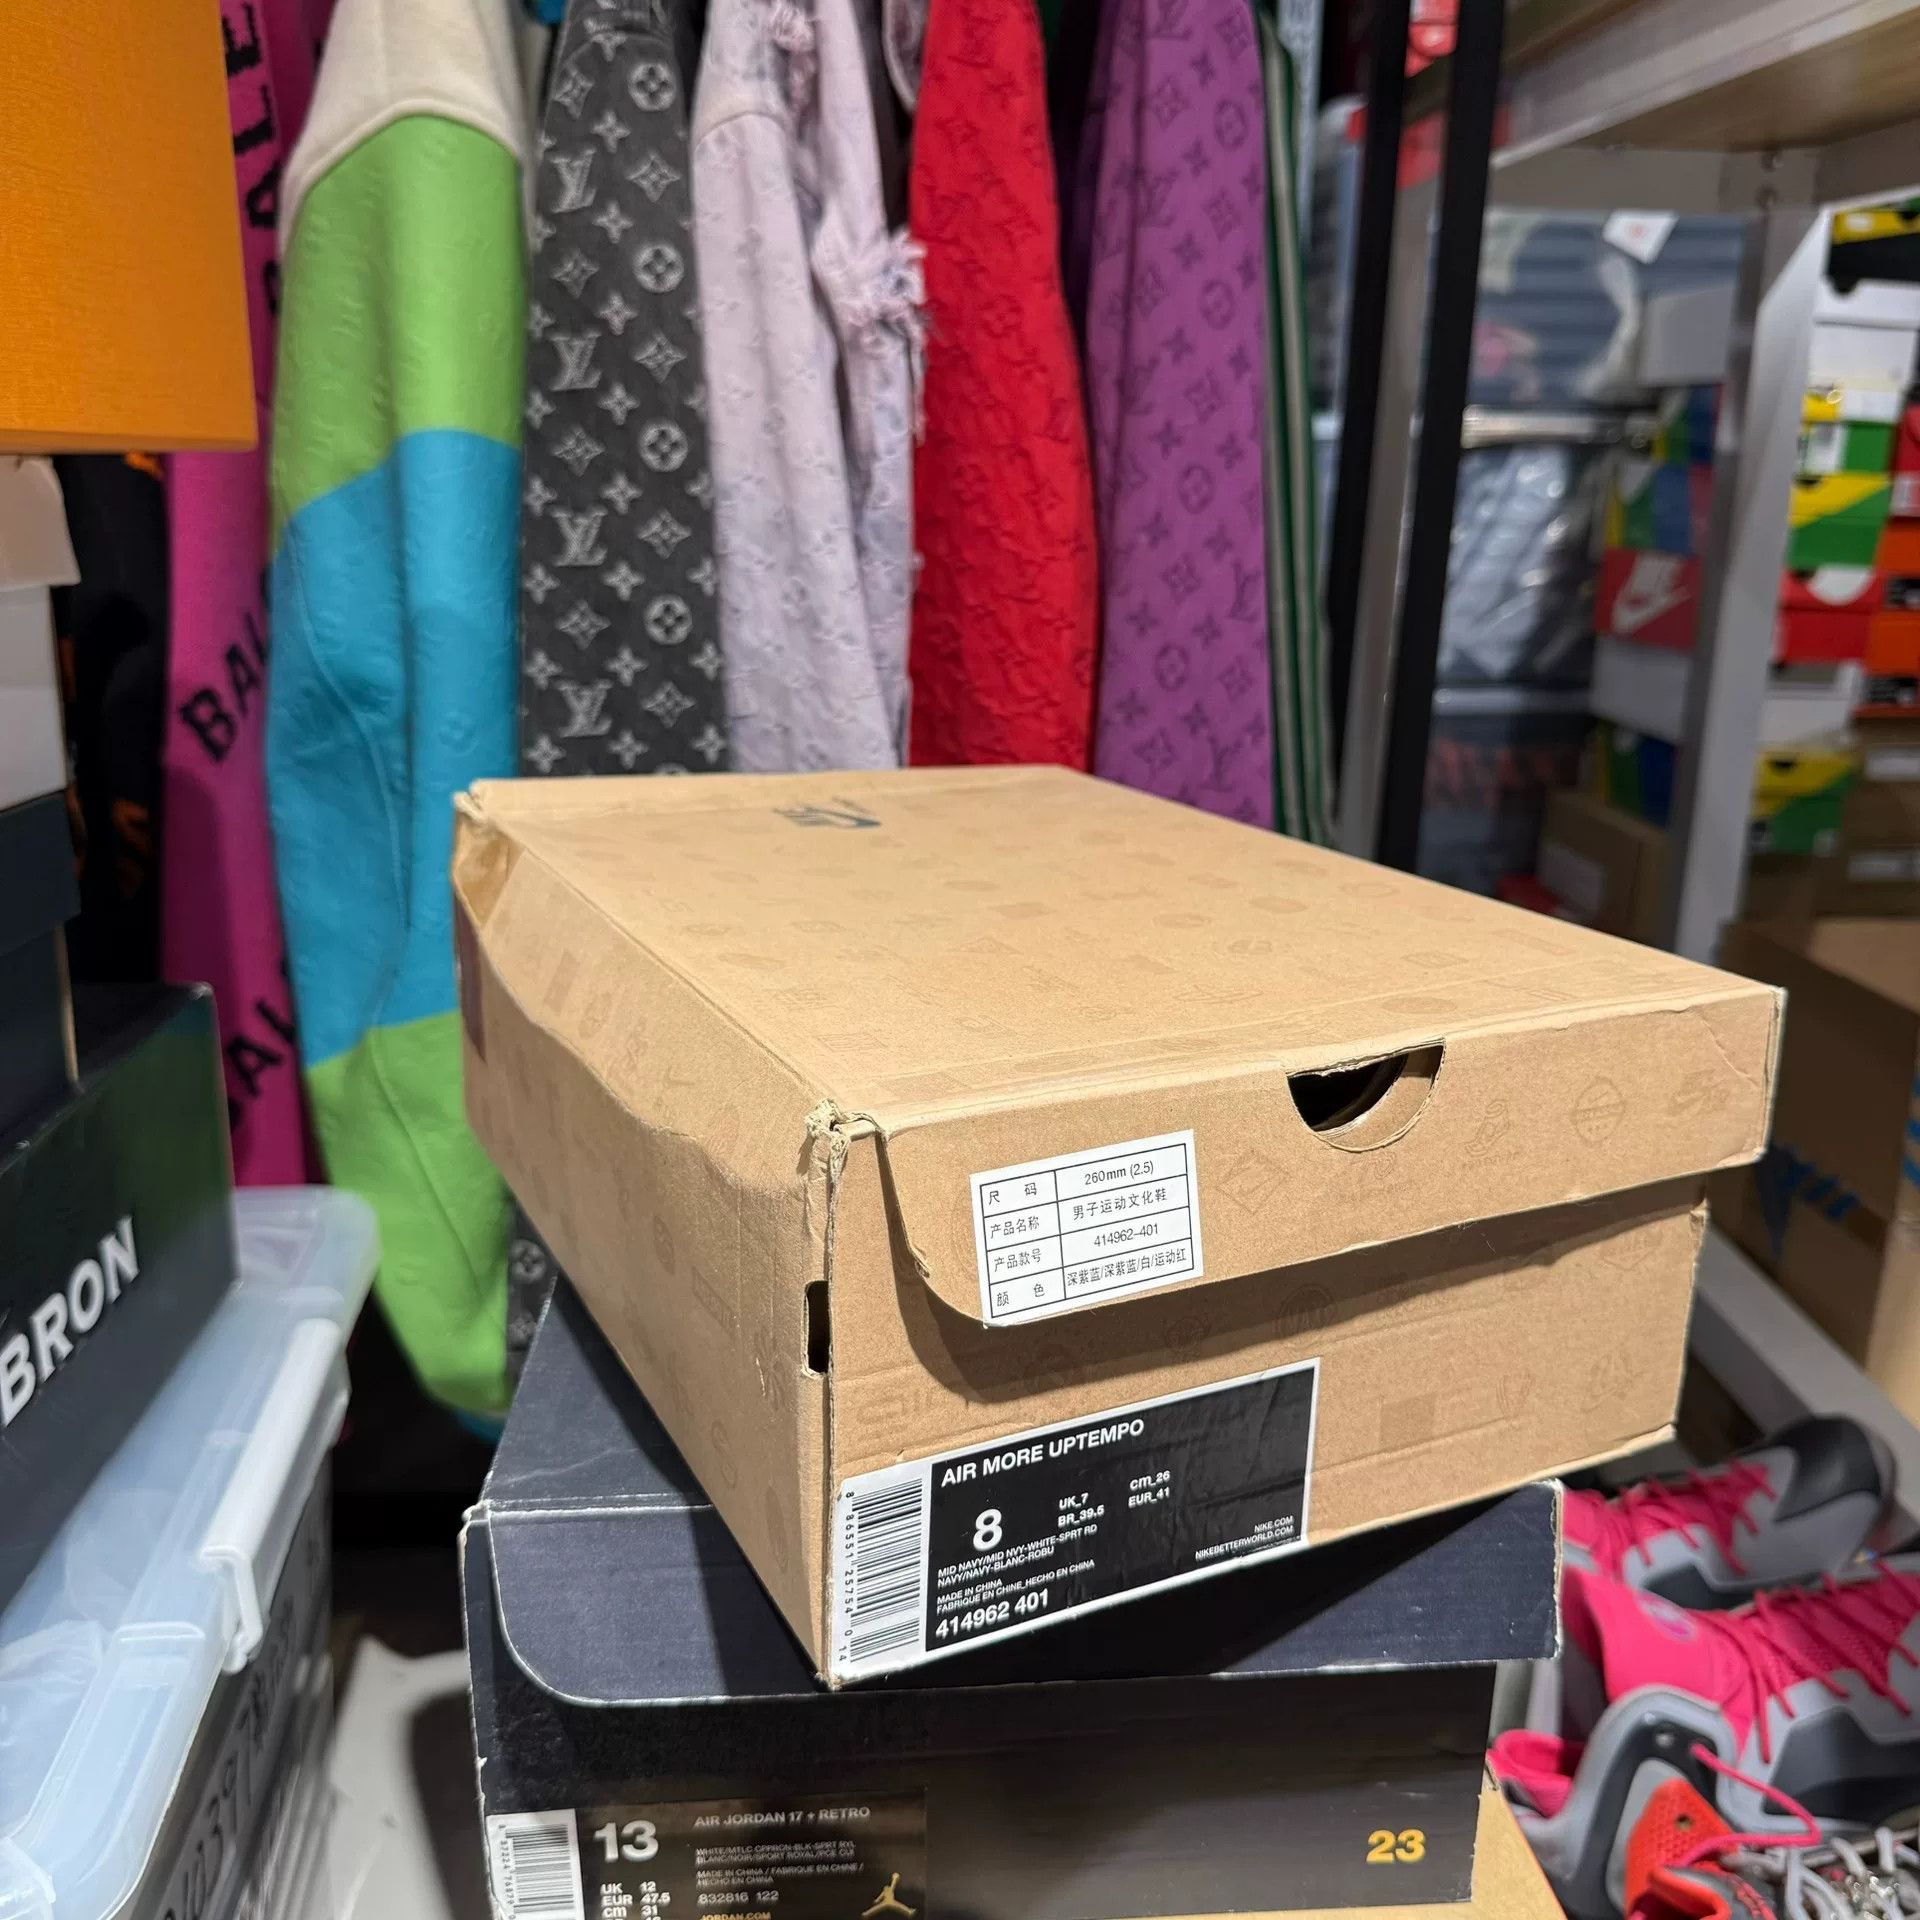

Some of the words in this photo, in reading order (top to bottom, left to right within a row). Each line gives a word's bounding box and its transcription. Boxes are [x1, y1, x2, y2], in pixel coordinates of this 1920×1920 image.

[1084, 1169, 1127, 1186] 260mm
[1129, 1160, 1154, 1179] (2.5)
[1073, 1187, 1168, 1220] 男子运动文化鞋
[990, 1216, 1040, 1239] 产品名称
[1094, 1223, 1159, 1247] 414962-401
[994, 1248, 1042, 1272] 产品款号
[941, 1461, 977, 1487] AIR
[982, 1445, 1044, 1475] MORE
[1049, 1418, 1145, 1458] UPTEMPO
[1059, 1493, 1089, 1510] UK_7
[1128, 1487, 1170, 1508] EUR_41
[972, 1508, 1003, 1550] 8
[1254, 1515, 1294, 1533] NIKE.COM
[938, 1565, 957, 1578] MID
[958, 1551, 1004, 1573] NAVY/MID
[1006, 1528, 1083, 1560] NVY-WHITE-SPRT
[1085, 1524, 1098, 1535] RD
[1195, 1525, 1294, 1561] NIKEBETTERWORLD.COM
[936, 1594, 981, 1615] FABRIQUE
[982, 1590, 994, 1600] EN
[1056, 1567, 1068, 1577] EN
[1069, 1559, 1095, 1573] CHINA
[937, 1589, 963, 1605] MADE
[965, 1585, 974, 1596] IN
[975, 1578, 1003, 1593] CHINA
[935, 1601, 1010, 1639] 414962
[1014, 1588, 1049, 1615] 401
[693, 1816, 720, 1828] AIR
[723, 1812, 786, 1826] JORDAN
[788, 1811, 803, 1823] 17
[818, 1806, 871, 1820] RETRO
[594, 1820, 659, 1863] 13
[1366, 1829, 1426, 1865] 23
[600, 1883, 623, 1895] UK
[640, 1881, 656, 1894] 12
[601, 1894, 633, 1907] EUR
[640, 1892, 671, 1905] 47.5
[697, 1892, 749, 1904] 832816
[756, 1890, 779, 1901] 122
[602, 1906, 627, 1918] cm
[641, 1904, 658, 1917] 31
